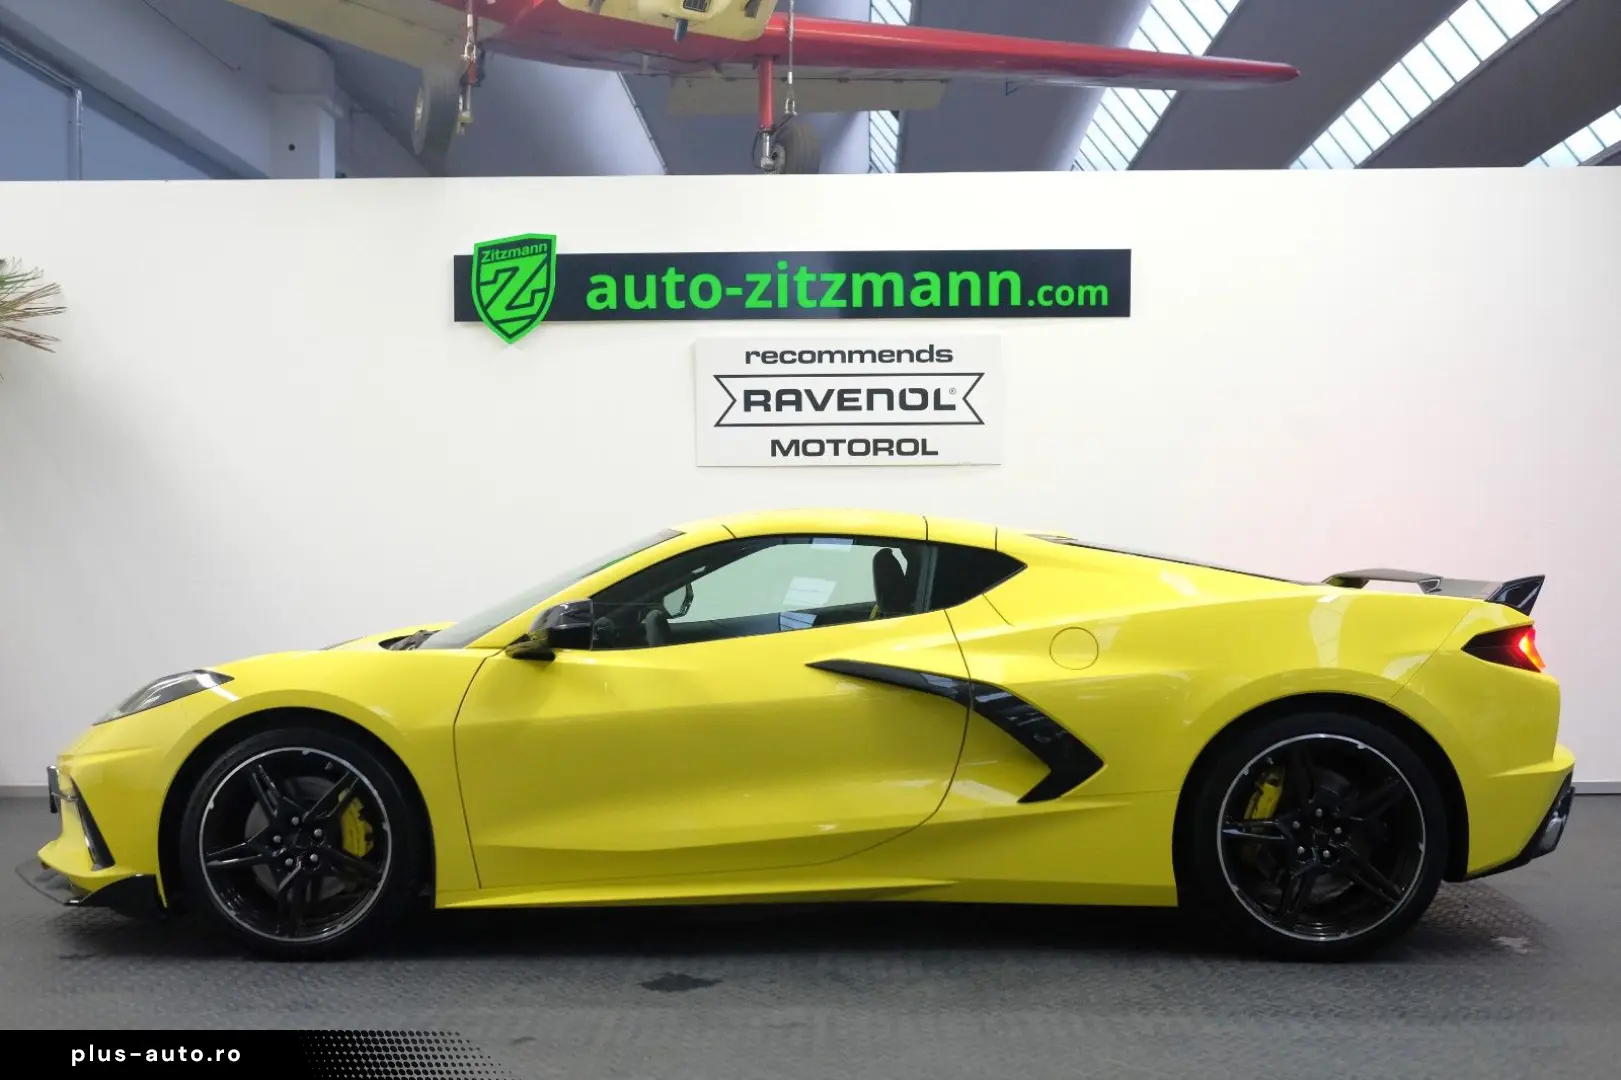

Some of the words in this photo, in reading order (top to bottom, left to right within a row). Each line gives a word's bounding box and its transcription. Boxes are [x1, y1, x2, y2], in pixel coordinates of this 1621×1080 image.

[481, 243, 547, 262] Zitzmann
[746, 344, 953, 364] recommends
[771, 438, 938, 457] MOTOROL
